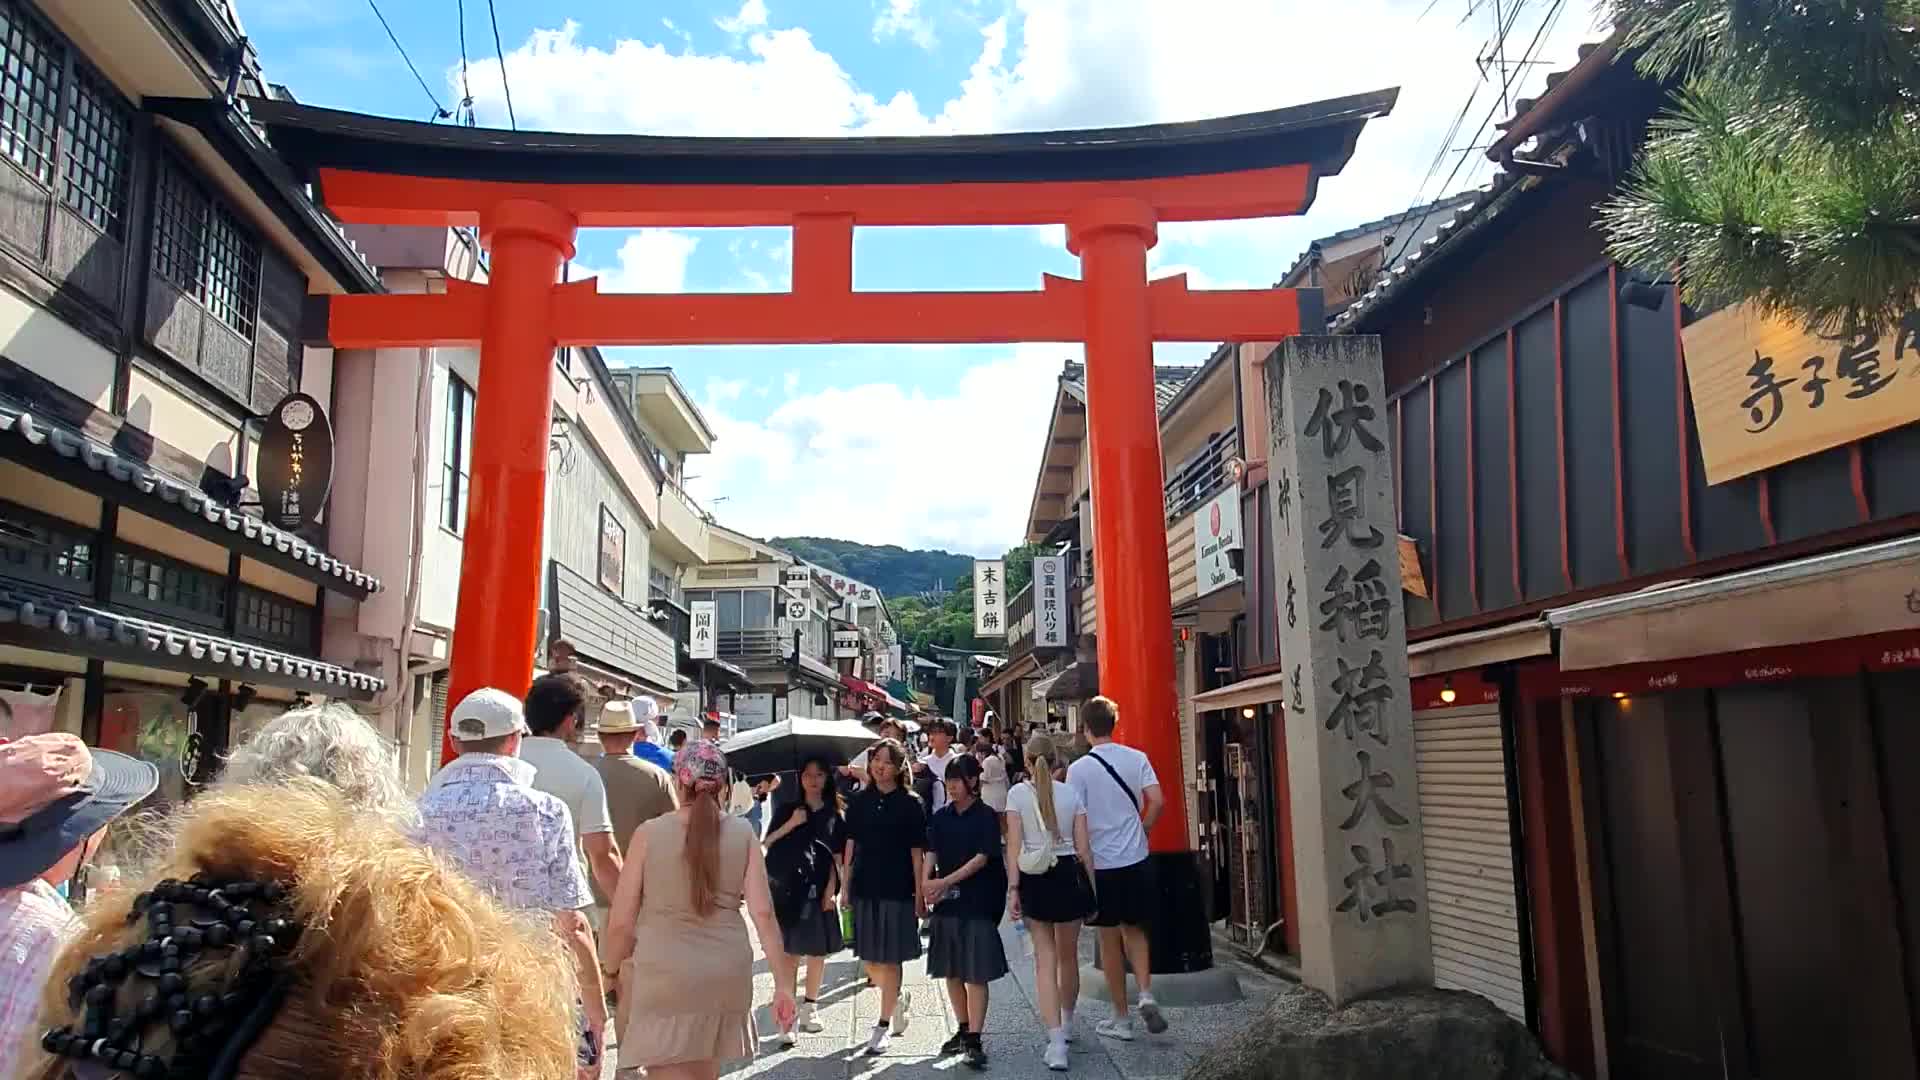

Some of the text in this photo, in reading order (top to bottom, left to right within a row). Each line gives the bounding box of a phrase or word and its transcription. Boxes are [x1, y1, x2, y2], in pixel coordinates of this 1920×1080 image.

[1304, 379, 1416, 922] 伏見稲荷大社
